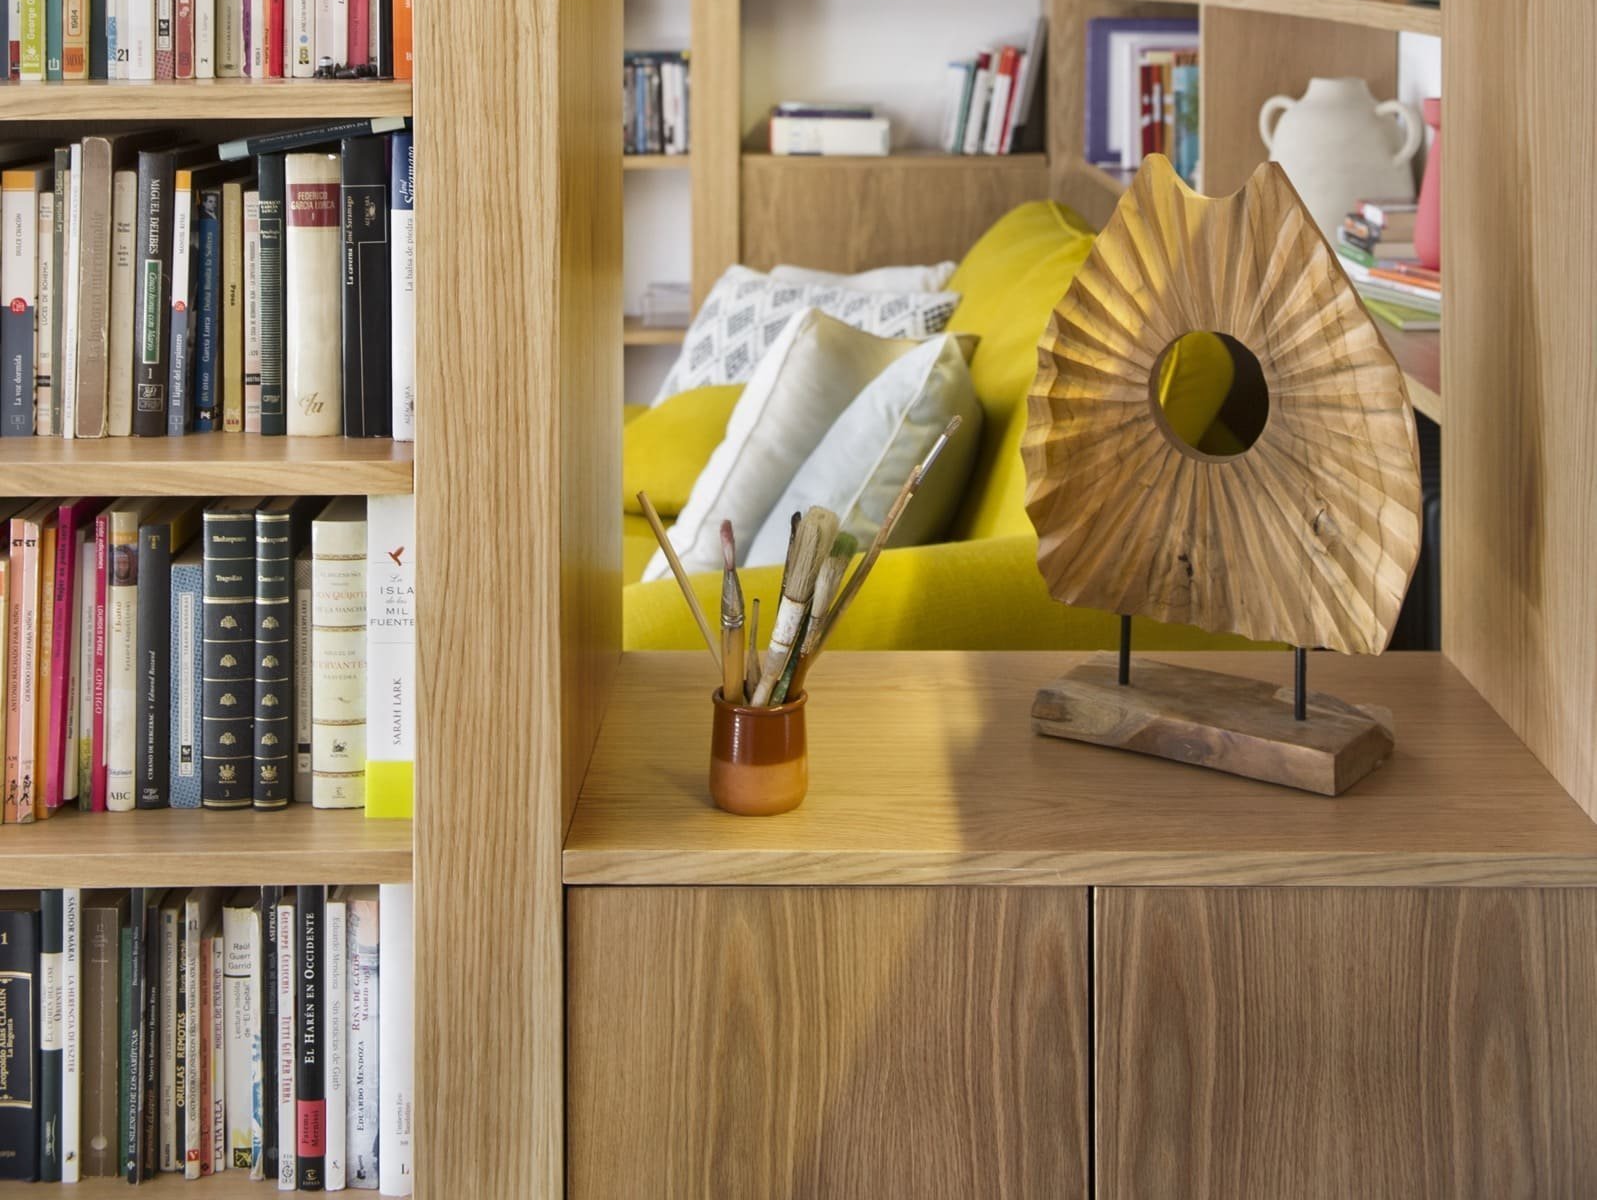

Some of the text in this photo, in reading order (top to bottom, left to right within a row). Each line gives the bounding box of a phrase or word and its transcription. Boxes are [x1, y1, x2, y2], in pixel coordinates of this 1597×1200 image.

[26, 7, 37, 40] George
[117, 48, 129, 62] 21
[149, 179, 160, 254] MIGUEL DELIBES
[346, 196, 354, 244] José Saramago
[404, 218, 414, 292] La balsa de piedra
[347, 276, 353, 285] La
[42, 293, 48, 302] DE
[174, 334, 184, 368] carpintero
[13, 354, 22, 383] dormida
[380, 586, 415, 596] ISLA
[370, 618, 415, 627] FUENTE
[386, 607, 409, 616] MIL
[95, 668, 103, 714] CONTIGO
[392, 677, 402, 745] SARAH LARK
[68, 897, 76, 932] SÁNDOR
[68, 976, 75, 984] LA
[303, 912, 315, 1064] EL HARÉN EN OCCIDENTE
[353, 989, 360, 1002] DE
[351, 1005, 360, 1031] RIÑA
[68, 1032, 75, 1041] DE
[7, 1049, 13, 1058] La
[176, 1012, 185, 1107] ORILLAS REMOTAS
[131, 1092, 137, 1104] DE
[356, 1041, 365, 1131] EDUARDO MENDOZA
[301, 1113, 309, 1144] Fatema
[311, 1110, 320, 1147] Mernissi
[130, 1145, 137, 1153] EL
